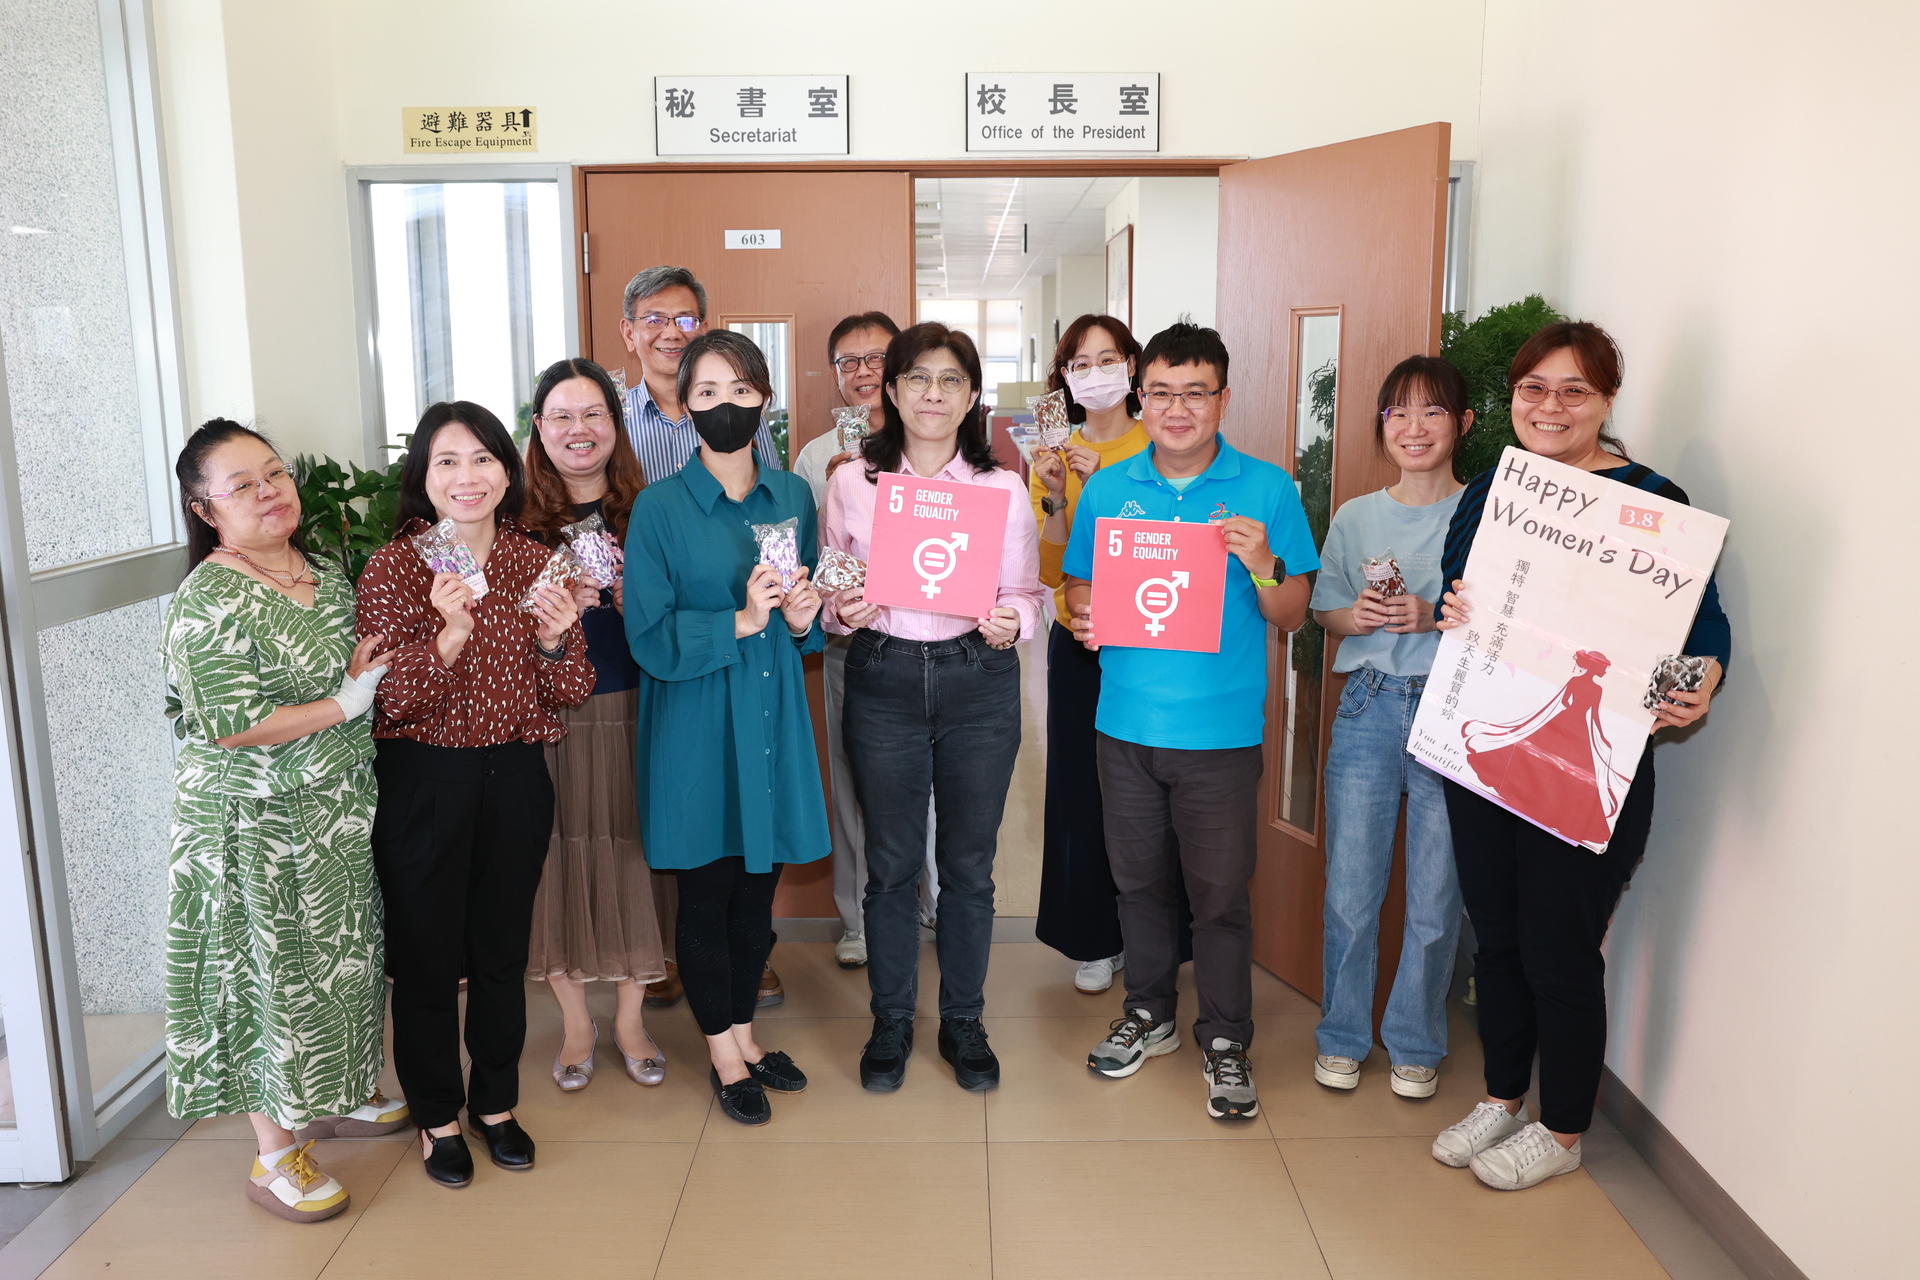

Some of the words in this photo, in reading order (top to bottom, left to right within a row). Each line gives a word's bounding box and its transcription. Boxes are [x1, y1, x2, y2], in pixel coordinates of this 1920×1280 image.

[665, 86, 839, 118] 秘書室
[976, 84, 1150, 115] 校長室
[420, 111, 521, 134] 避難器具
[709, 127, 797, 143] Secretariat
[981, 125, 1023, 139] Office
[1031, 125, 1044, 139] of
[1053, 125, 1074, 139] the
[1082, 125, 1146, 139] President
[410, 137, 431, 148] Fire
[435, 137, 472, 149] Escape
[475, 137, 532, 149] Equipment
[741, 233, 766, 246] 603
[888, 485, 905, 513] 5
[915, 488, 953, 506] GENDER
[1503, 457, 1599, 518] Happy
[913, 504, 960, 522] EQUALITY
[1624, 508, 1655, 528] 3.8
[1108, 529, 1123, 557] 5
[1133, 531, 1172, 546] GENDER
[1493, 496, 1618, 564] Women's
[1628, 548, 1693, 600] Day
[1132, 545, 1179, 562] EQUALITY
[1480, 622, 1508, 676] 充滿活力
[1440, 629, 1481, 721] 致天生麗質的妳
[1418, 728, 1436, 745] You
[1440, 743, 1460, 756] Are
[1412, 741, 1463, 773] Beautiful
